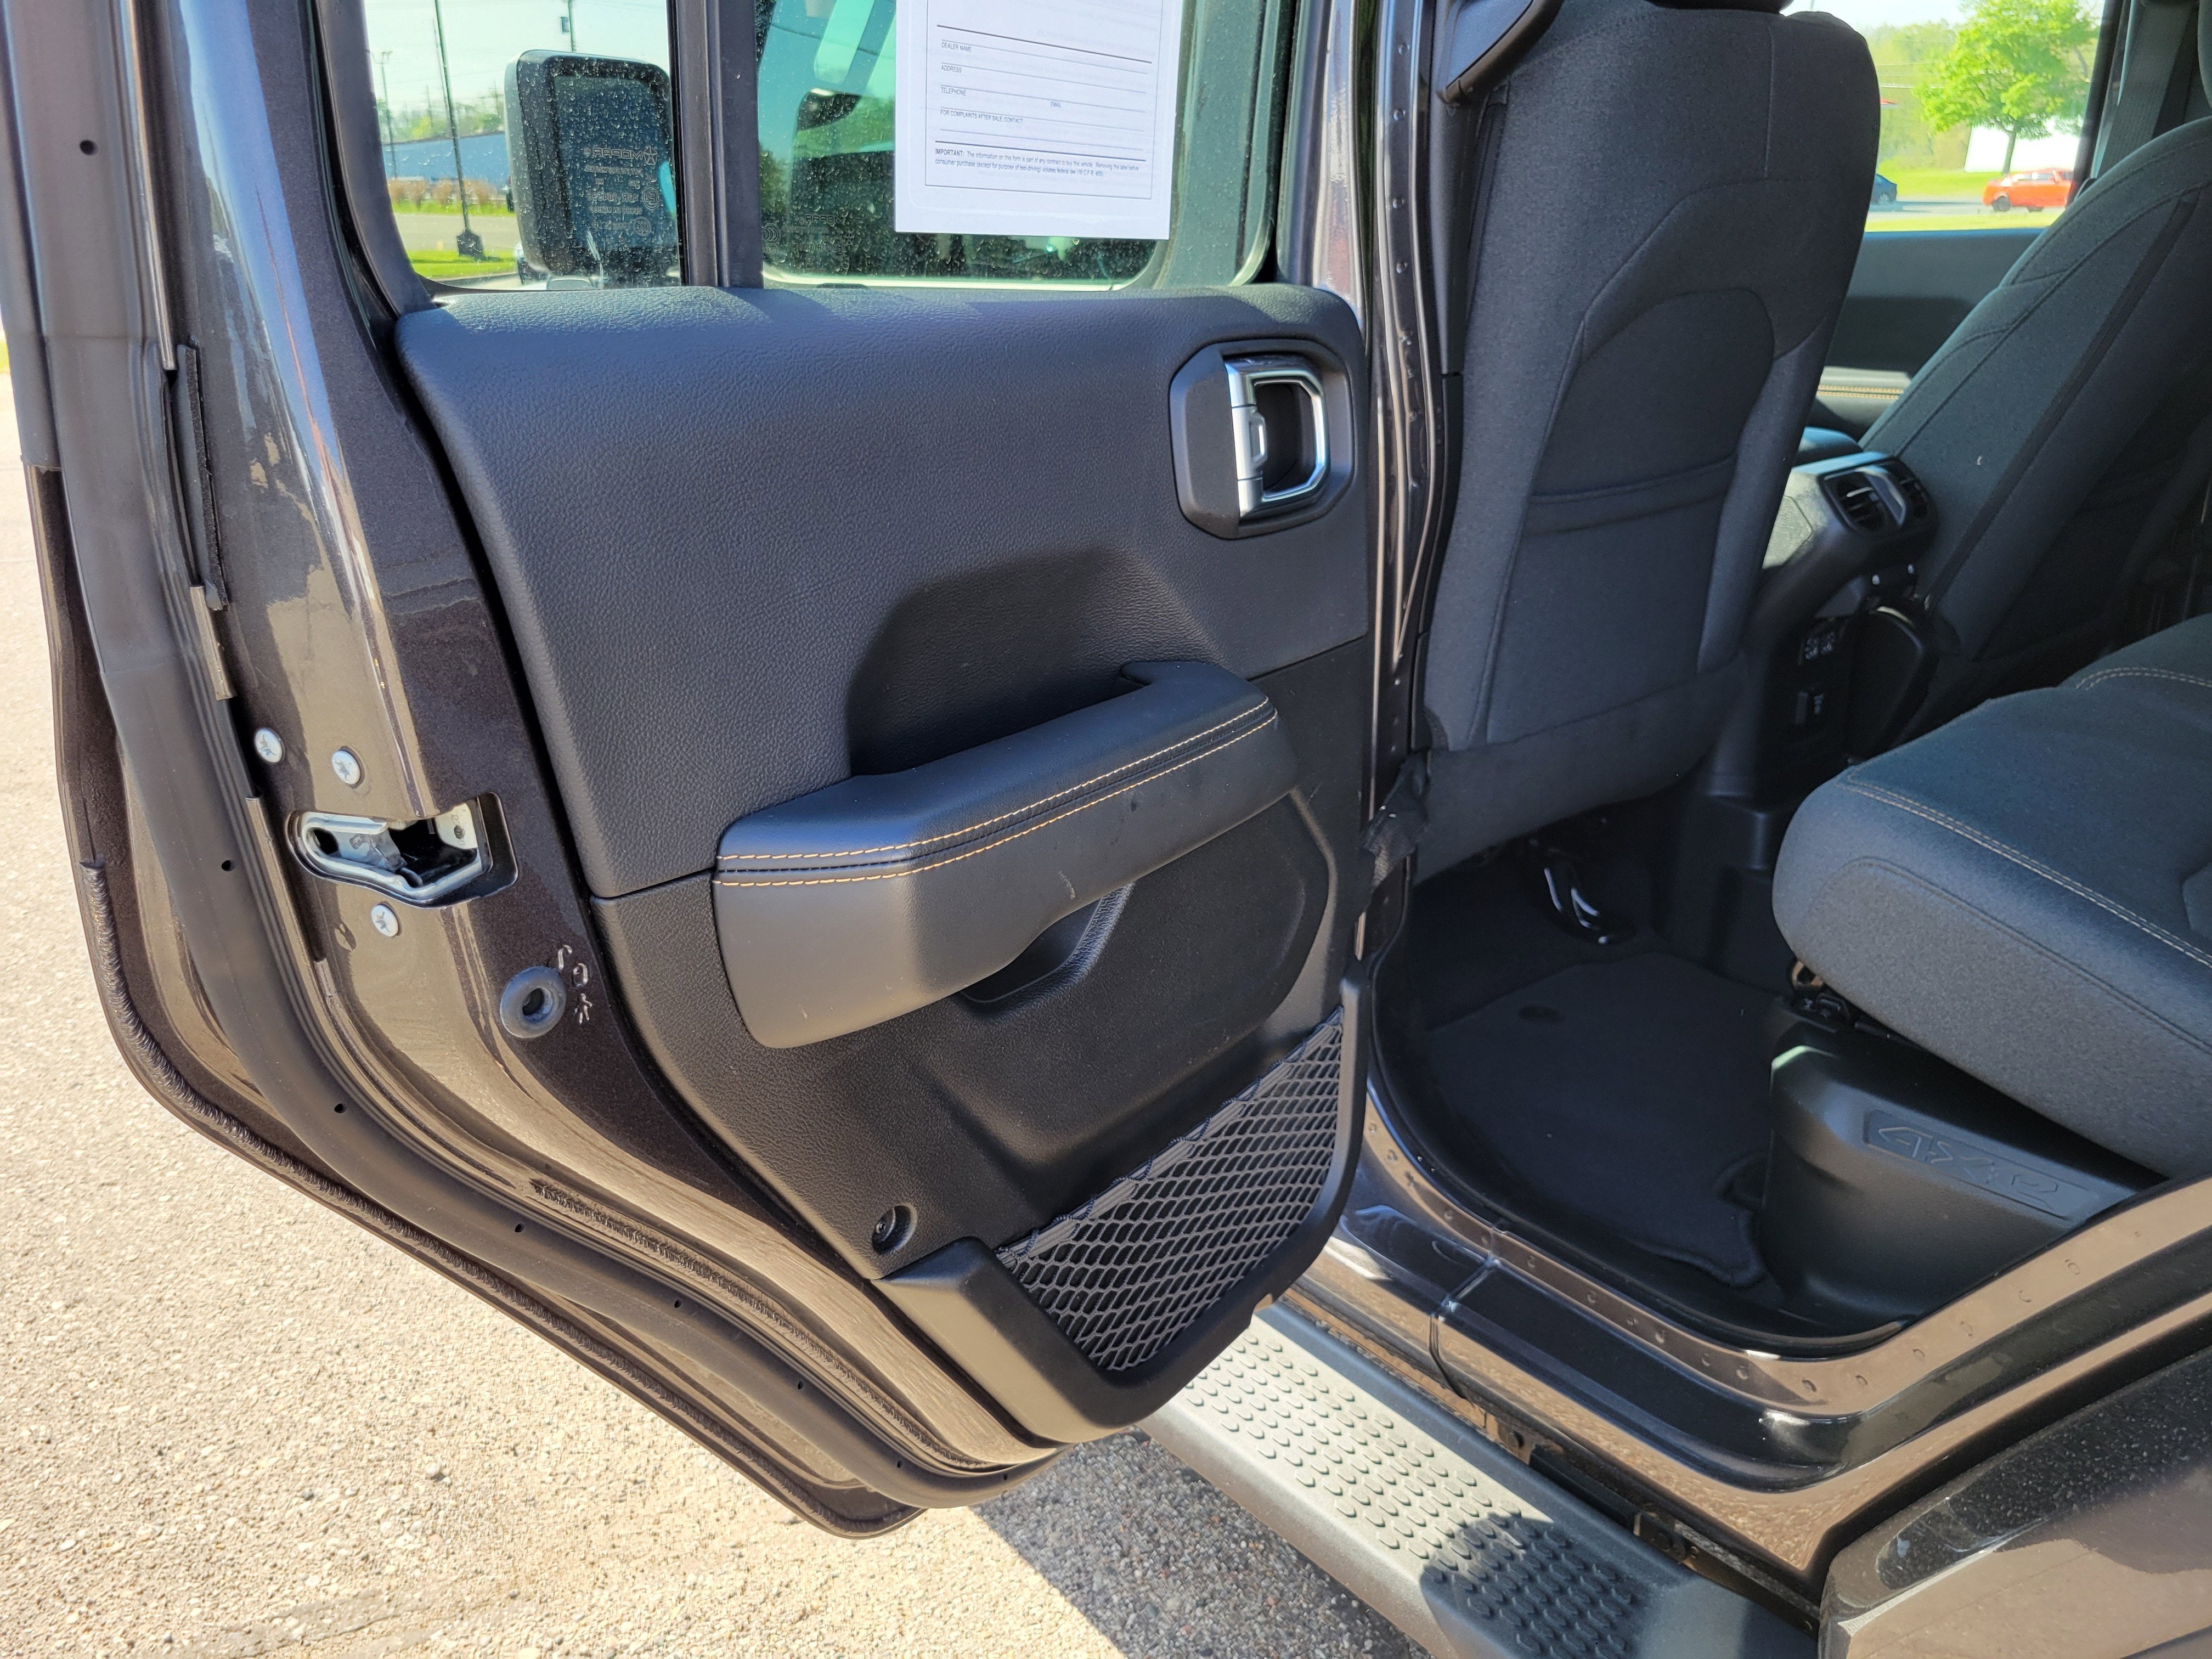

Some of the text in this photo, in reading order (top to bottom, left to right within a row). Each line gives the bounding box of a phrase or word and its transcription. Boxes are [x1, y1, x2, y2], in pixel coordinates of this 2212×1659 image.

[941, 65, 962, 73] ADDRESS
[940, 87, 967, 96] TELEPHONE
[951, 110, 978, 119] COMPLAINTS
[935, 148, 964, 157] IMPORTANT:
